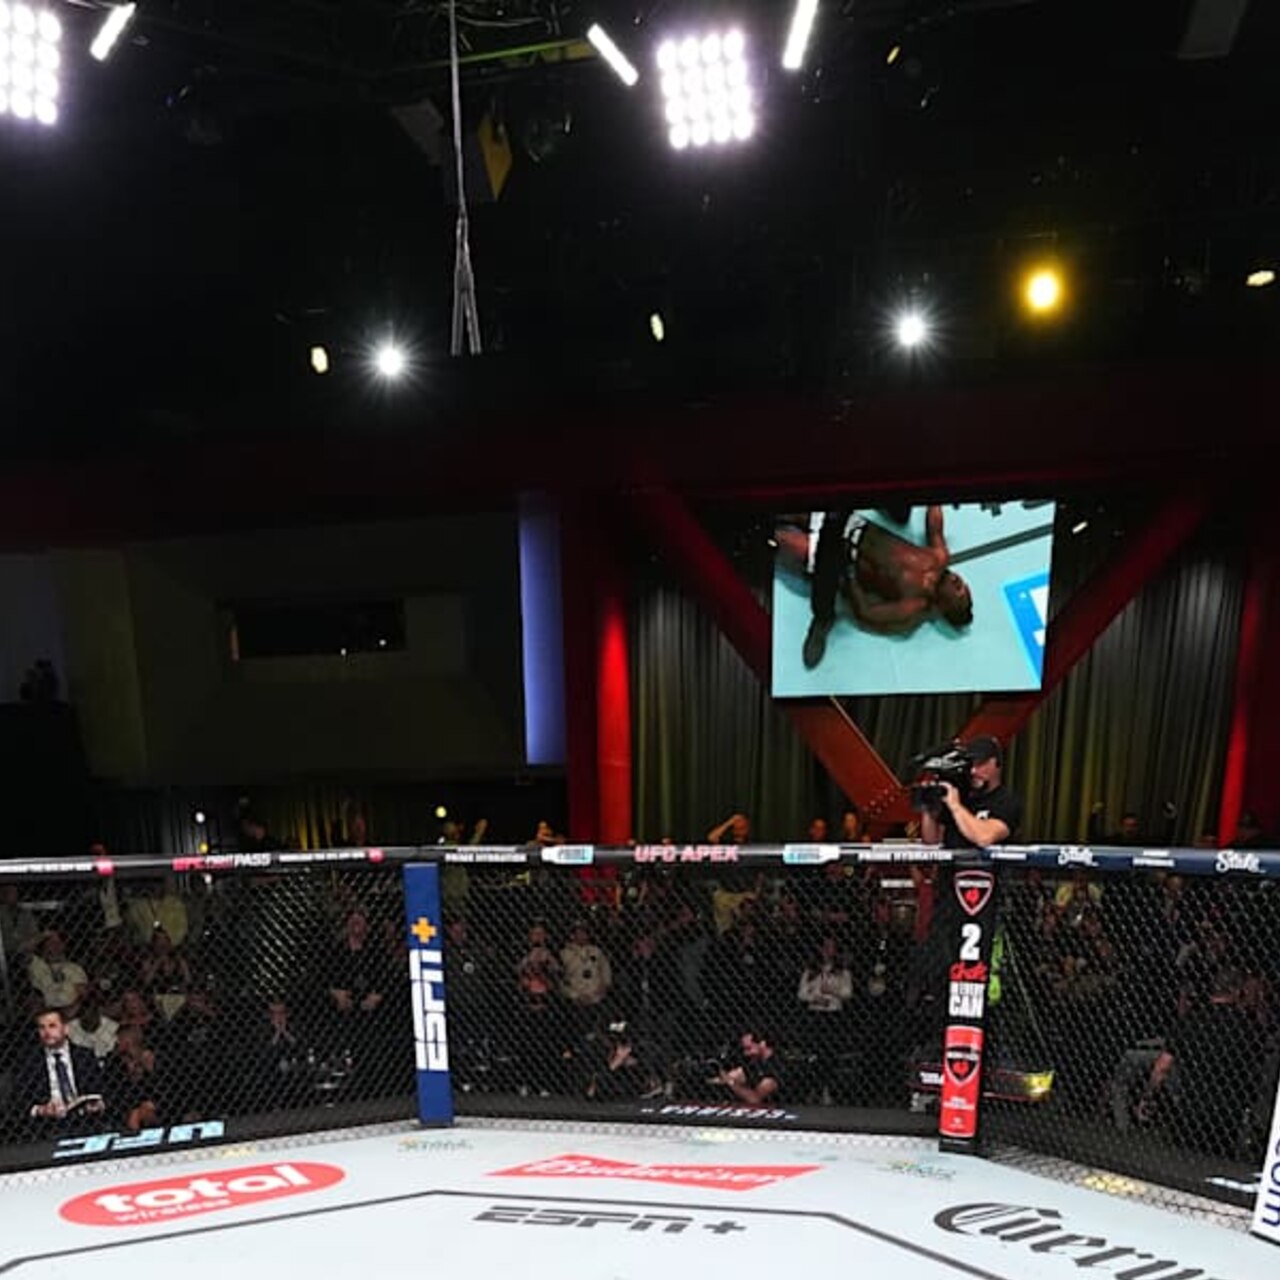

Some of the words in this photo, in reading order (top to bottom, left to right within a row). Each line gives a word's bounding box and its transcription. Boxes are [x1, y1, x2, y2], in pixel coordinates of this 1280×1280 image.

[634, 845, 677, 863] UFC
[679, 845, 739, 863] APEX
[959, 923, 982, 961] 2
[94, 1164, 312, 1214] total
[114, 1197, 233, 1222] wireless
